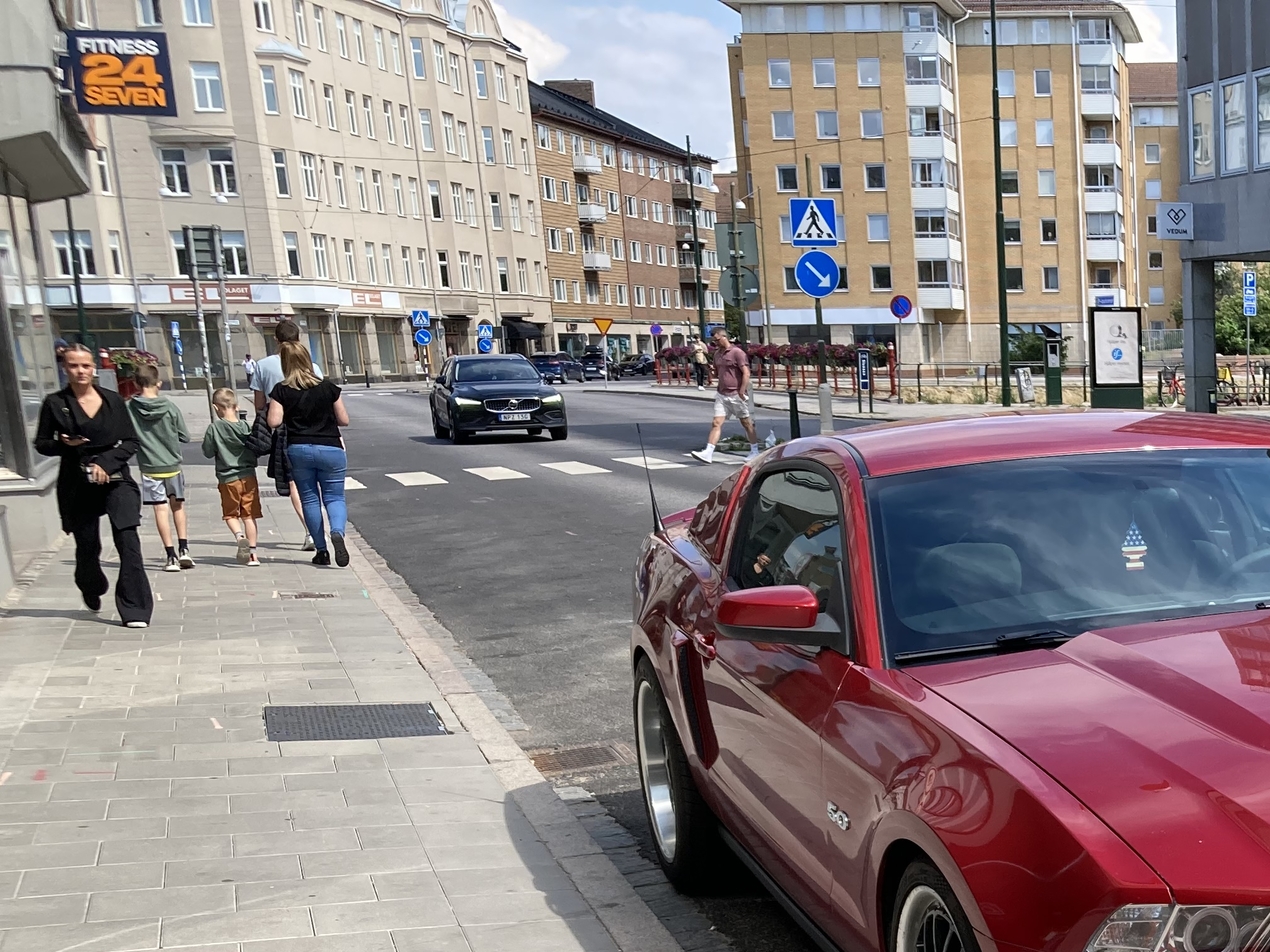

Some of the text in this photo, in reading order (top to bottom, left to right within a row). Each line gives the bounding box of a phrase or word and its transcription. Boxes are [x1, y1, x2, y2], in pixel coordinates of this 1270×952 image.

[76, 37, 160, 56] FITNESS
[81, 54, 164, 87] 24
[83, 85, 167, 107] SEVEN
[1246, 273, 1254, 286] P
